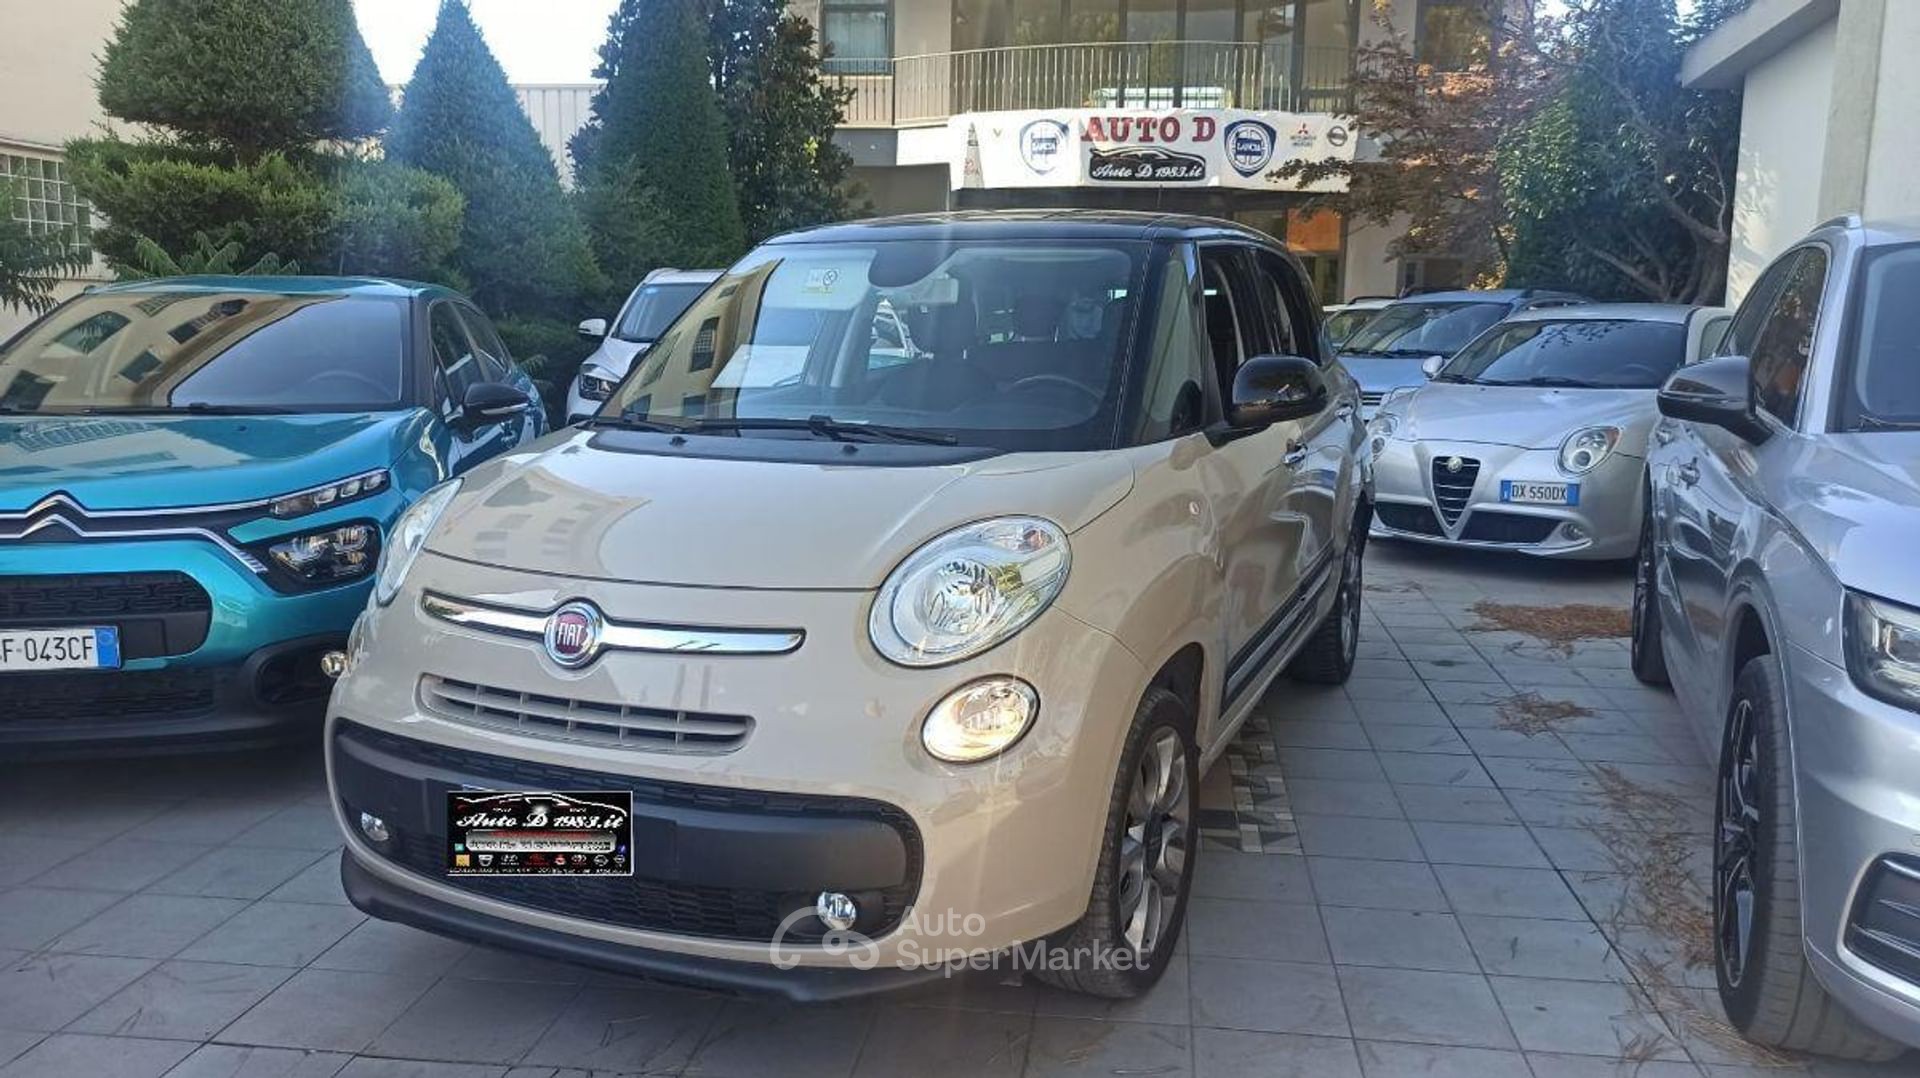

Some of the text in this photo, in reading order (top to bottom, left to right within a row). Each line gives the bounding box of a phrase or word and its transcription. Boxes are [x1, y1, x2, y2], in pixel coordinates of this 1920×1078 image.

[1080, 116, 1216, 142] AUTO D
[1092, 163, 1203, 178] Auto D 1983.it
[1511, 484, 1567, 500] DX 550DX
[556, 622, 585, 647] FIAT
[24, 635, 95, 662] 043CF
